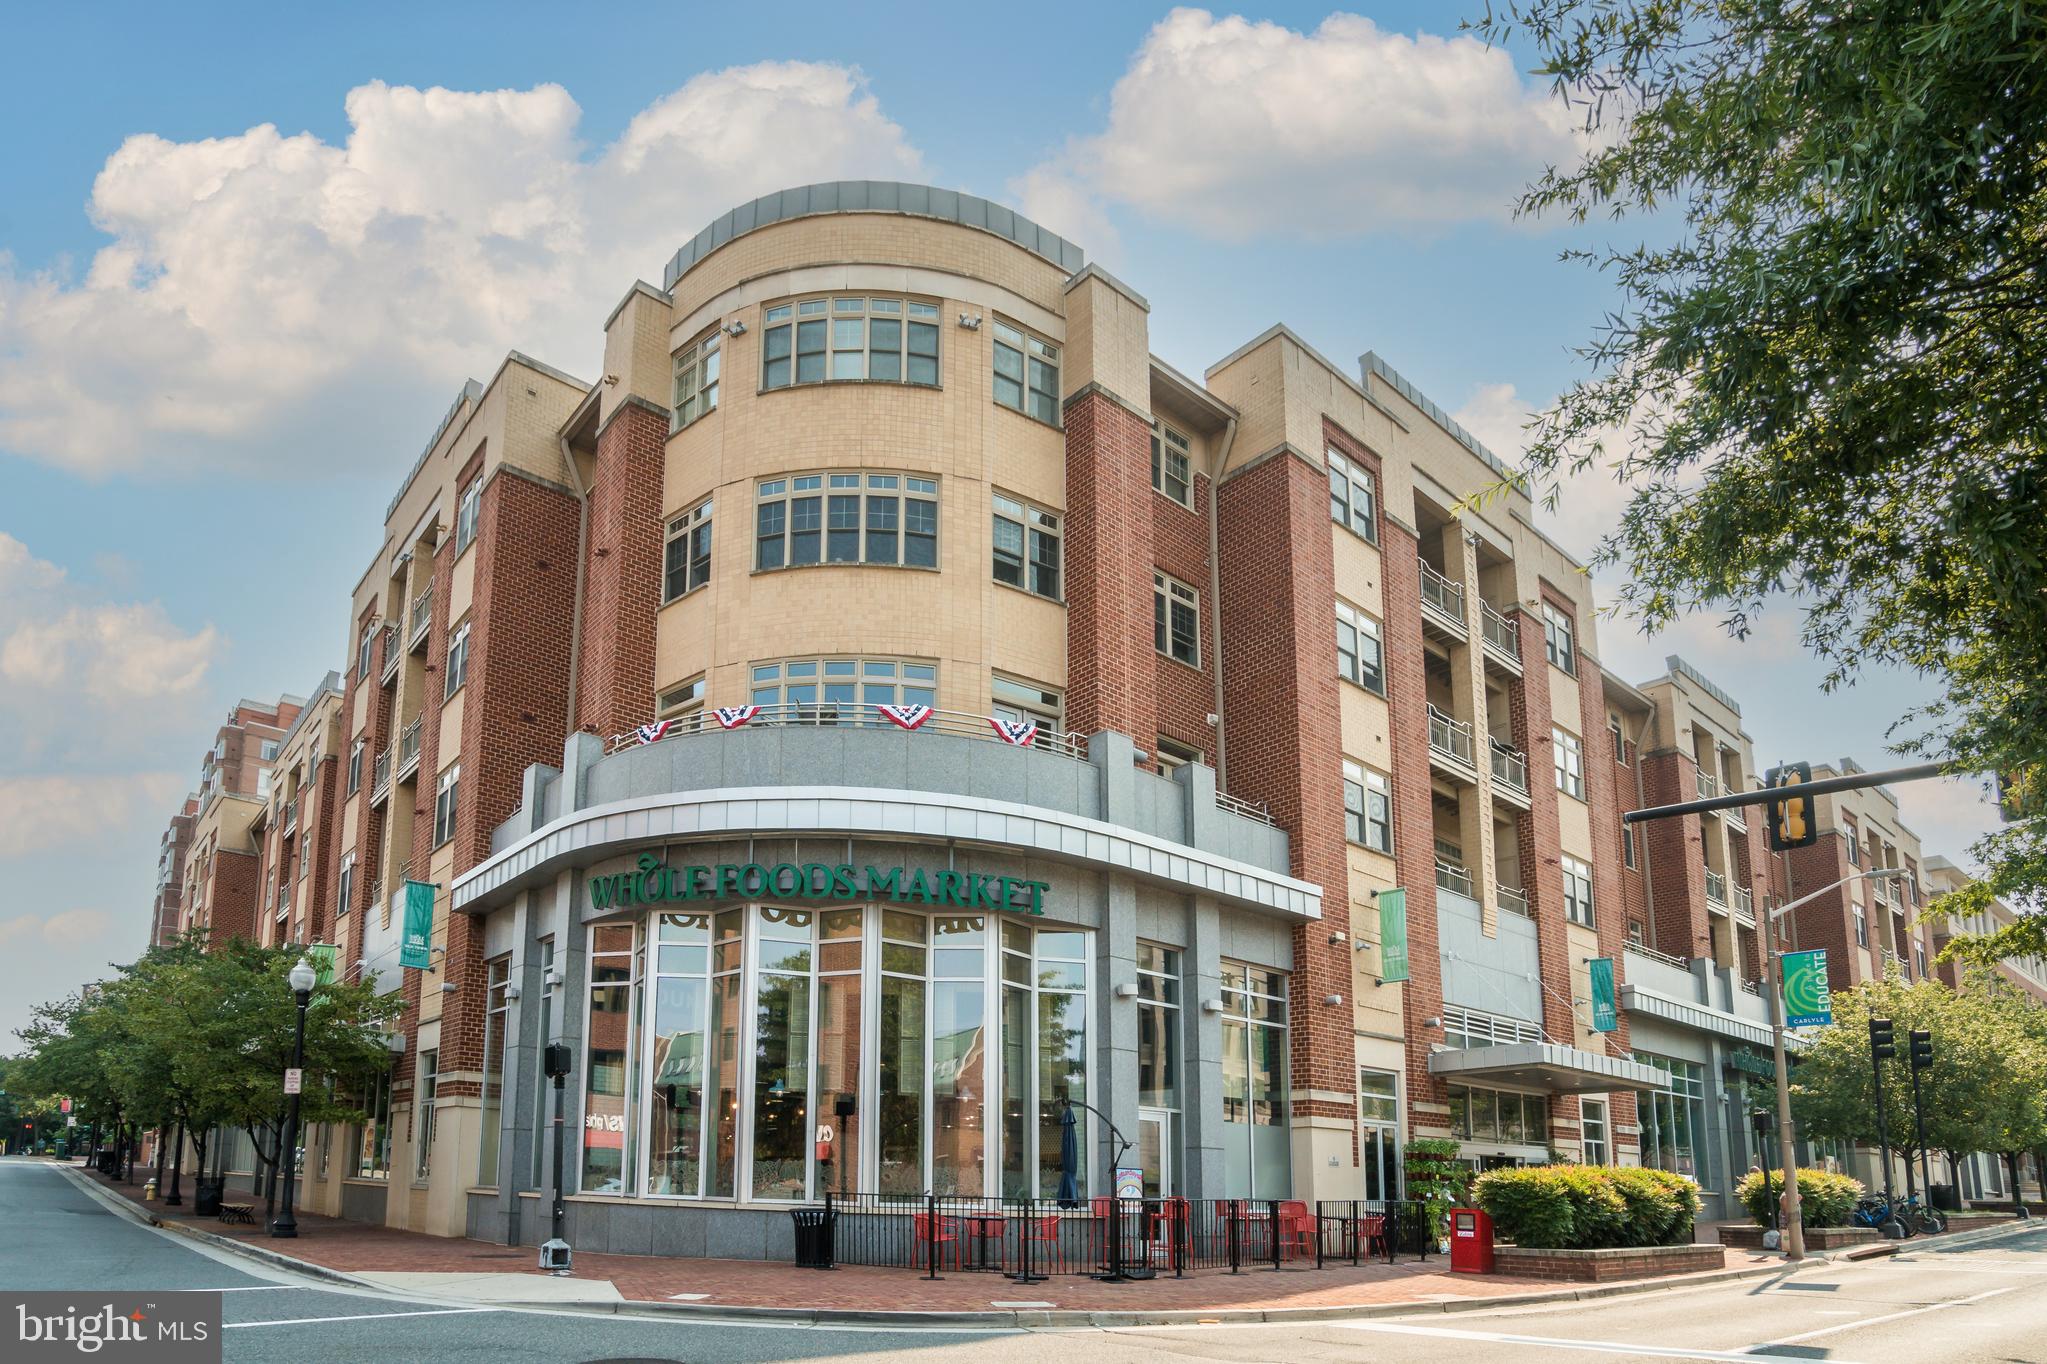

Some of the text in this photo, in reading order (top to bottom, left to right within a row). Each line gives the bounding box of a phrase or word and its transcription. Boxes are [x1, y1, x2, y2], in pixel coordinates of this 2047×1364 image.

[588, 852, 1050, 916] WHOLE FOODS MARKET
[1814, 951, 1831, 1012] EDUCATE
[1793, 1016, 1825, 1024] CARLYLE
